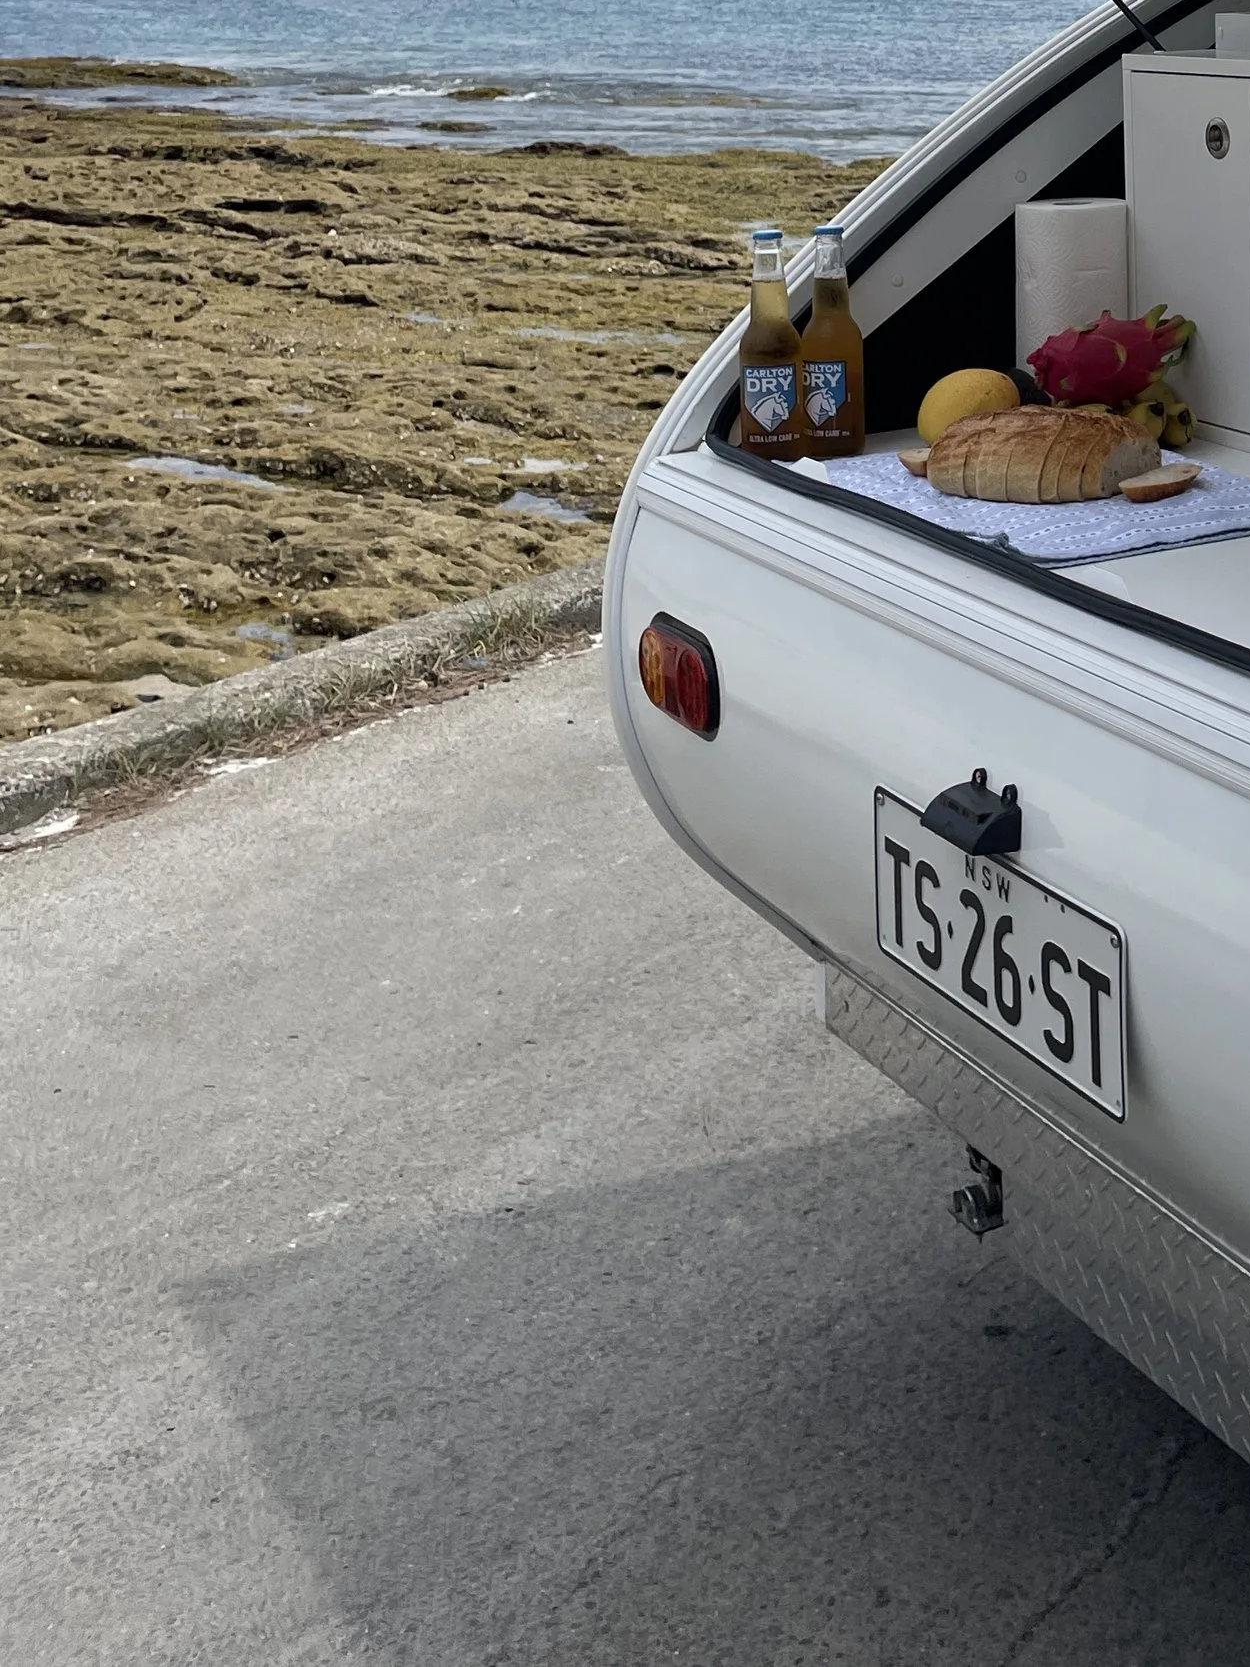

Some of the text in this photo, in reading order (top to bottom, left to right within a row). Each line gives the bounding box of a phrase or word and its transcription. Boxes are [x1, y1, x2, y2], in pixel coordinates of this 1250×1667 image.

[746, 367, 793, 378] CARLTON
[746, 375, 793, 392] DRY
[765, 435, 778, 443] LOW
[965, 854, 1011, 903] NSW
